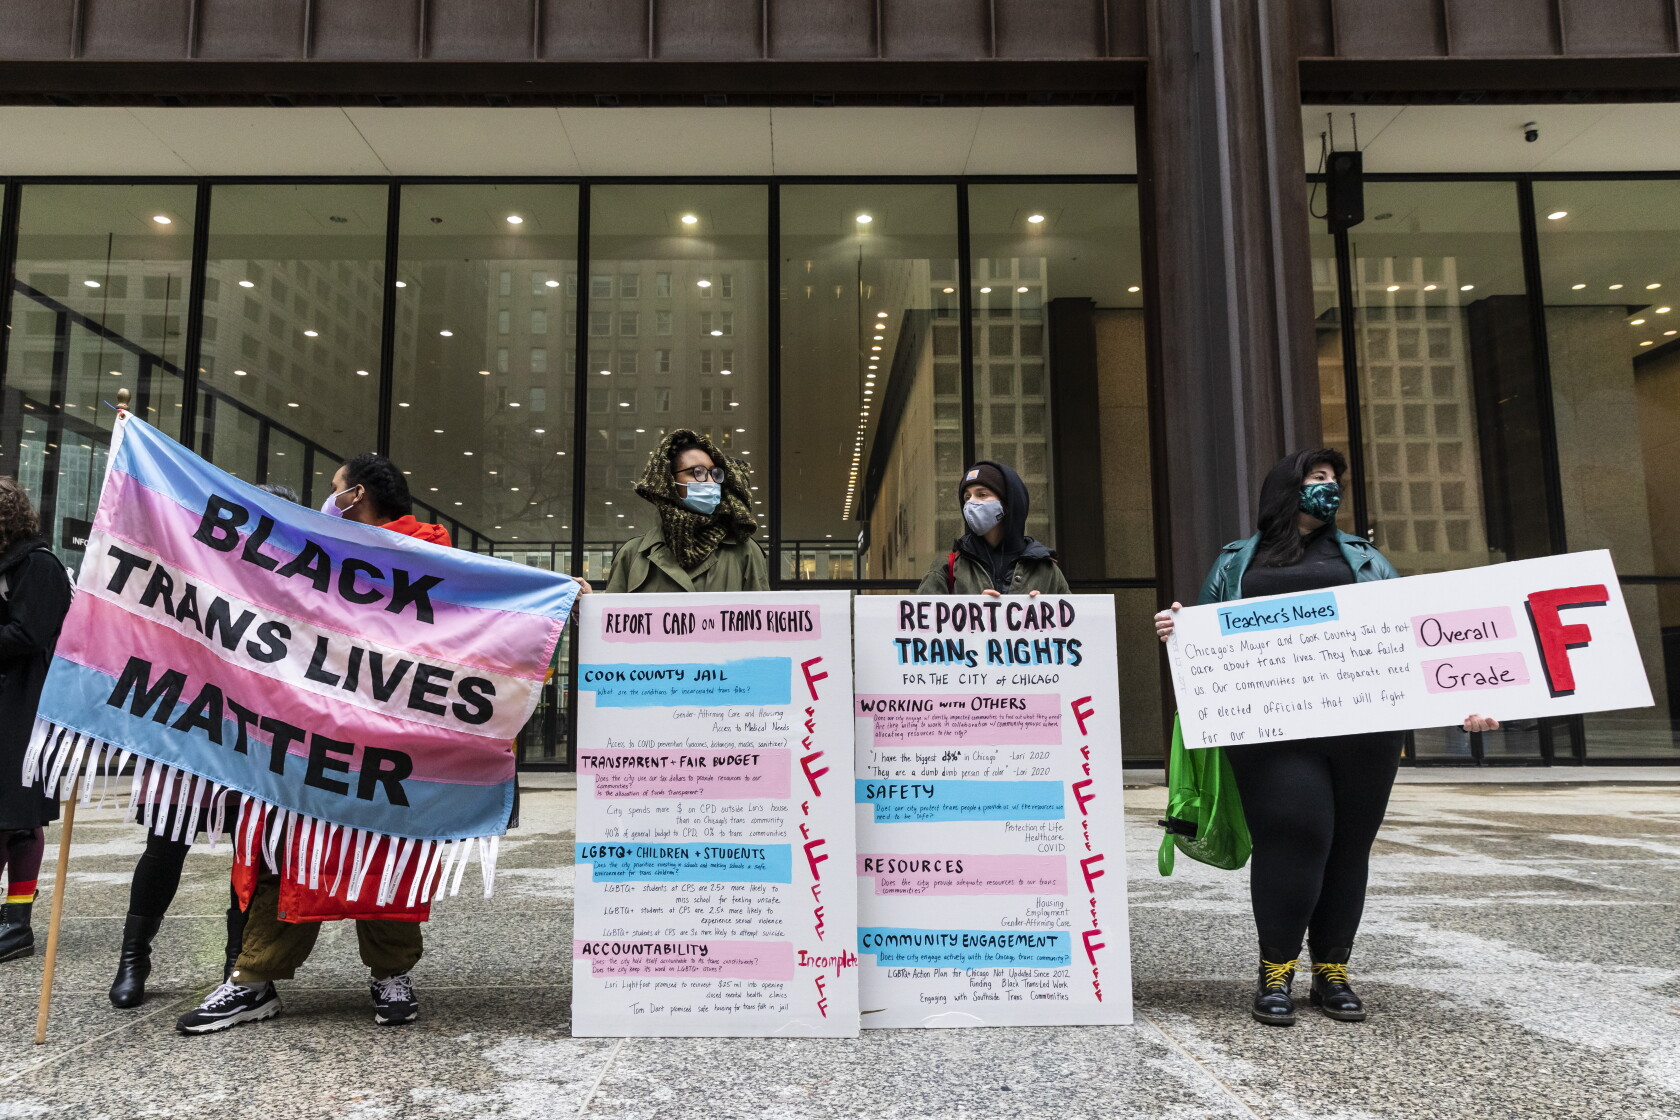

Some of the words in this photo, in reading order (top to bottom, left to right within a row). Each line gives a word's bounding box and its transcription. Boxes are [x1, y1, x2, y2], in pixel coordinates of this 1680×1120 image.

[193, 494, 445, 625] BLACK
[606, 612, 652, 635] REPORT
[663, 612, 695, 635] CARD
[720, 609, 762, 632] TRANS
[767, 610, 813, 633] RIGHTS
[900, 600, 1001, 633] REPORT
[1006, 599, 1075, 631] CARD
[1221, 608, 1289, 630] Teacher's
[1293, 604, 1335, 623] Notes
[106, 545, 291, 663] TRANS
[304, 635, 496, 725] LIVES
[1421, 618, 1498, 646] Overall
[1184, 643, 1235, 660] Chicago's
[1240, 640, 1271, 655] Mayor
[1277, 635, 1292, 647] and
[1300, 633, 1319, 644] Cook
[1324, 629, 1357, 641] County
[1361, 625, 1376, 635] Jail
[1381, 623, 1391, 633] do
[1395, 623, 1409, 632] not
[1524, 584, 1610, 698] F
[989, 638, 1082, 666] RIGHTS
[1190, 665, 1214, 675] care
[1224, 661, 1250, 671] about
[1257, 657, 1286, 666] trans
[1319, 649, 1344, 663] They
[1351, 647, 1372, 658] have
[1378, 642, 1404, 654] failed
[584, 670, 626, 682] COOK
[630, 669, 684, 682] COUNTY
[694, 669, 728, 682] JAIL
[801, 656, 828, 701] F
[903, 674, 926, 685] FOR
[929, 673, 948, 685] THE
[959, 674, 987, 685] CITY
[996, 675, 1006, 685] of
[1012, 674, 1059, 685] CHICAGO
[1213, 682, 1227, 693] Our
[1236, 676, 1295, 691] communities
[1320, 672, 1329, 680] in
[1337, 669, 1380, 682] desparate
[1388, 663, 1409, 674] need
[1436, 663, 1515, 688] Grade
[860, 700, 933, 712] WORKING
[971, 697, 1026, 710] OTHERS
[1218, 704, 1251, 717] elected
[1264, 700, 1312, 714] officials
[1321, 697, 1343, 708] that
[1353, 693, 1372, 704] will
[1381, 691, 1405, 706] fight
[727, 709, 741, 718] Care
[745, 710, 755, 718] and
[758, 709, 784, 720] Housing
[1071, 695, 1095, 736] F
[106, 656, 413, 807] MATTER
[712, 722, 732, 732] Access
[735, 723, 742, 732] to
[744, 722, 767, 732] Medical
[771, 722, 790, 731] Needs
[1202, 731, 1218, 744] for
[1230, 731, 1245, 740] our
[581, 755, 669, 769] TRANSPARENT
[680, 755, 706, 768] FAIR
[713, 754, 759, 766] BUDGET
[882, 752, 897, 763] have
[900, 752, 908, 762] the
[916, 752, 937, 765] biggest
[964, 753, 970, 761] in
[1029, 752, 1050, 760] 2020
[800, 750, 829, 797] F
[895, 768, 906, 776] are
[921, 766, 938, 777] dumb
[942, 766, 957, 777] dumb
[961, 768, 980, 779] person
[983, 766, 991, 777] of
[1029, 766, 1050, 776] 2020
[867, 785, 934, 799] SAFETY
[1072, 779, 1096, 816] F
[607, 805, 623, 817] City
[628, 805, 650, 816] spends
[676, 802, 683, 814] $
[700, 803, 717, 814] CPD
[721, 803, 744, 813] outside
[748, 803, 764, 813] Lori's
[770, 803, 788, 812] house
[1005, 822, 1038, 833] Protection
[1039, 822, 1047, 831] of
[1048, 822, 1064, 831] Life
[1025, 833, 1064, 843] Healthcare
[582, 847, 633, 859] LGBTQ+
[637, 847, 689, 859] CHILDREN
[704, 847, 765, 860] STUDENTS
[1038, 843, 1065, 853] COVID
[803, 839, 828, 881] F
[864, 858, 963, 874] RESOURCES
[1080, 854, 1105, 893] F
[1036, 898, 1064, 910] Housing
[1026, 908, 1070, 918] Employment
[863, 934, 957, 948] COMMUNITY
[962, 934, 1058, 948] ENGAGEMENT
[1082, 929, 1106, 966] F
[582, 943, 708, 956] ACCOUNTABILITY
[797, 948, 858, 978] Incomplete
[888, 969, 911, 978] LGBTQ+
[912, 969, 931, 978] Action
[933, 968, 947, 978] Plan
[952, 968, 961, 978] for
[966, 968, 989, 980] Chicago
[993, 969, 1004, 978] Not
[1008, 968, 1032, 979] Updated
[1034, 969, 1050, 978] Since
[1052, 968, 1070, 978] 2012
[969, 979, 991, 990] Funding
[1002, 978, 1019, 988] Black
[1052, 979, 1068, 988] Work
[920, 992, 947, 1004] Engaging
[954, 992, 968, 1001] with
[972, 991, 1000, 1001] Southside
[1005, 990, 1023, 1002] Trans
[1030, 991, 1069, 1001] Communities
